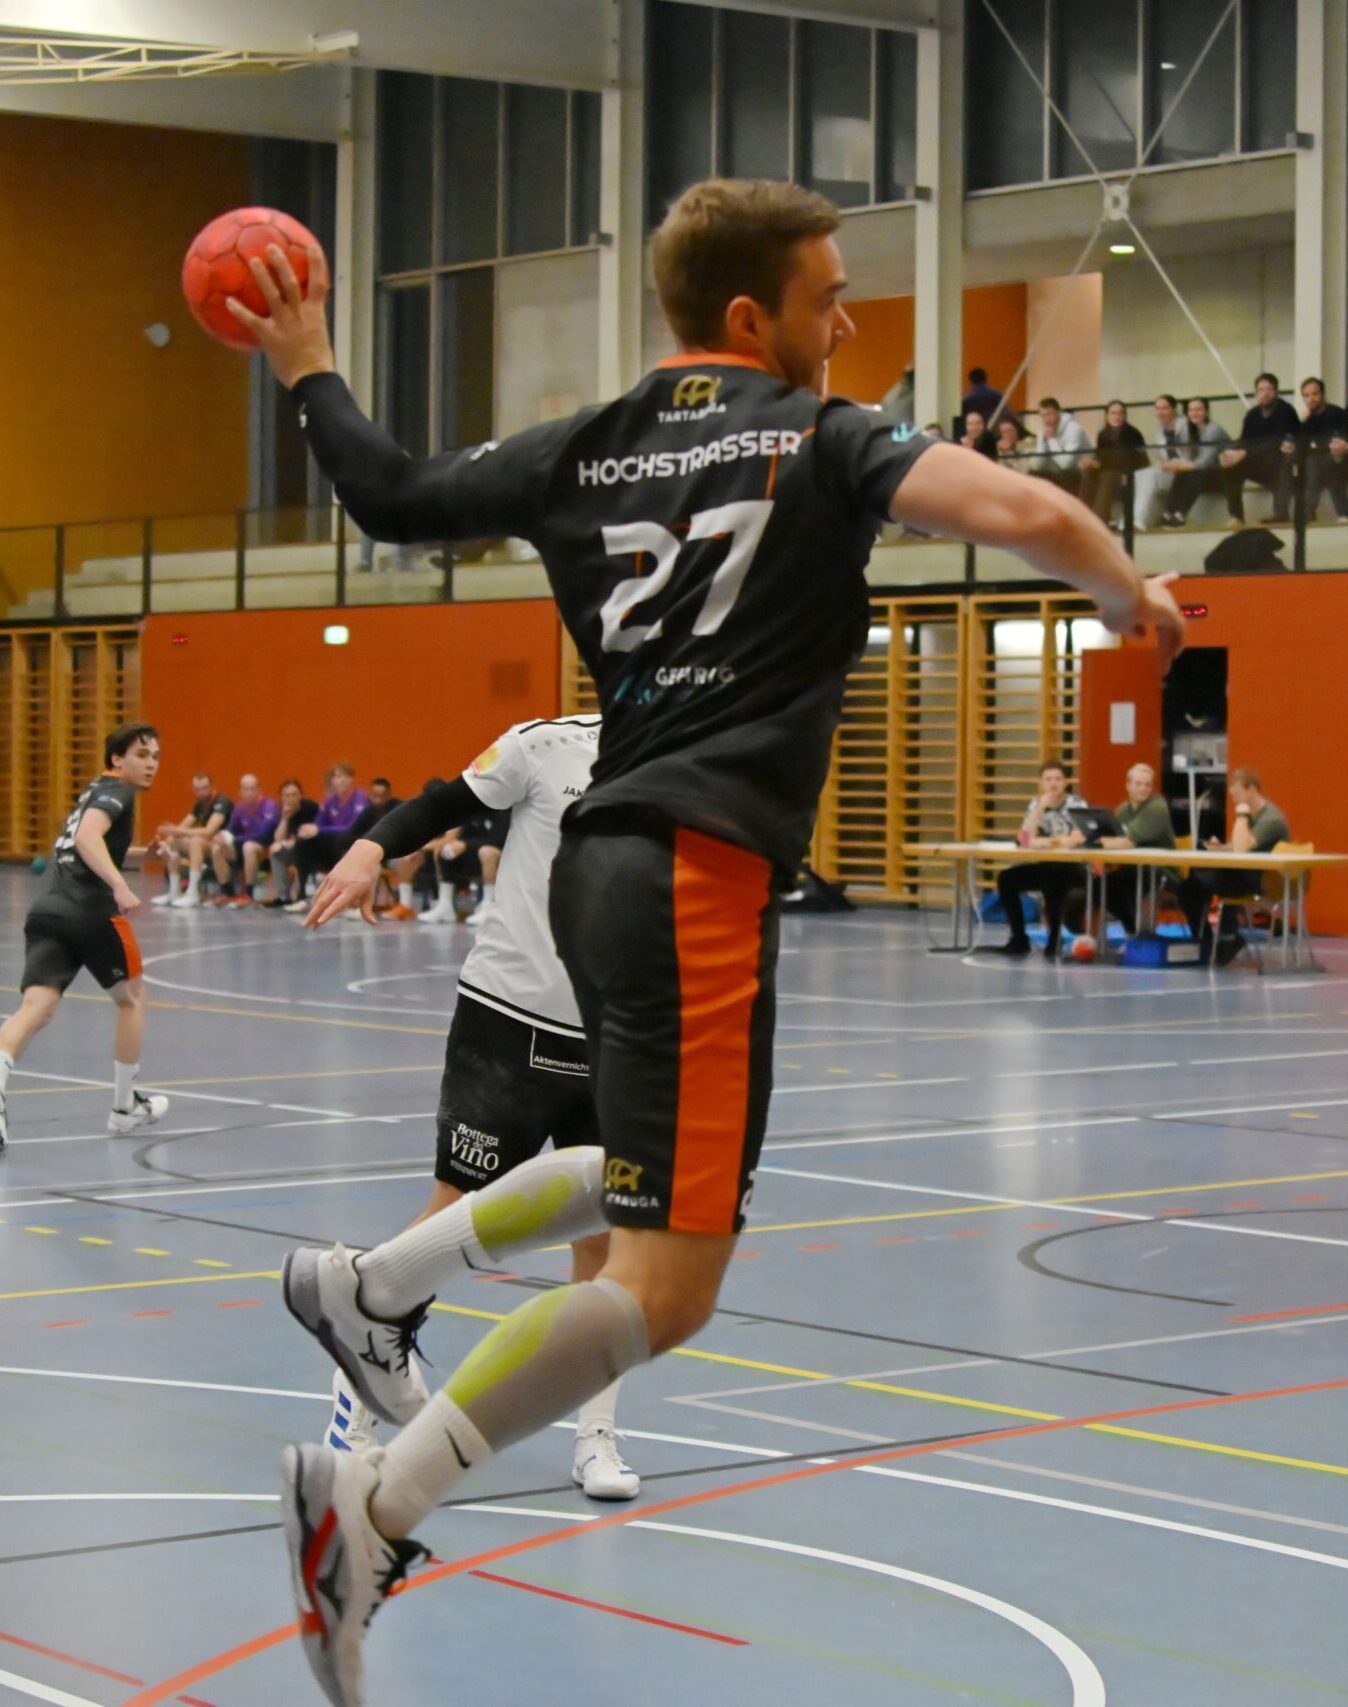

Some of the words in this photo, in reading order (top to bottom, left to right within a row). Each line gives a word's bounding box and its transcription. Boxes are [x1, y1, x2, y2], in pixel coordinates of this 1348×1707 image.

[578, 430, 801, 486] HOCHSTRASSER
[600, 500, 775, 653] 27
[451, 1129, 499, 1171] Vino
[457, 1122, 499, 1147] Bottega
